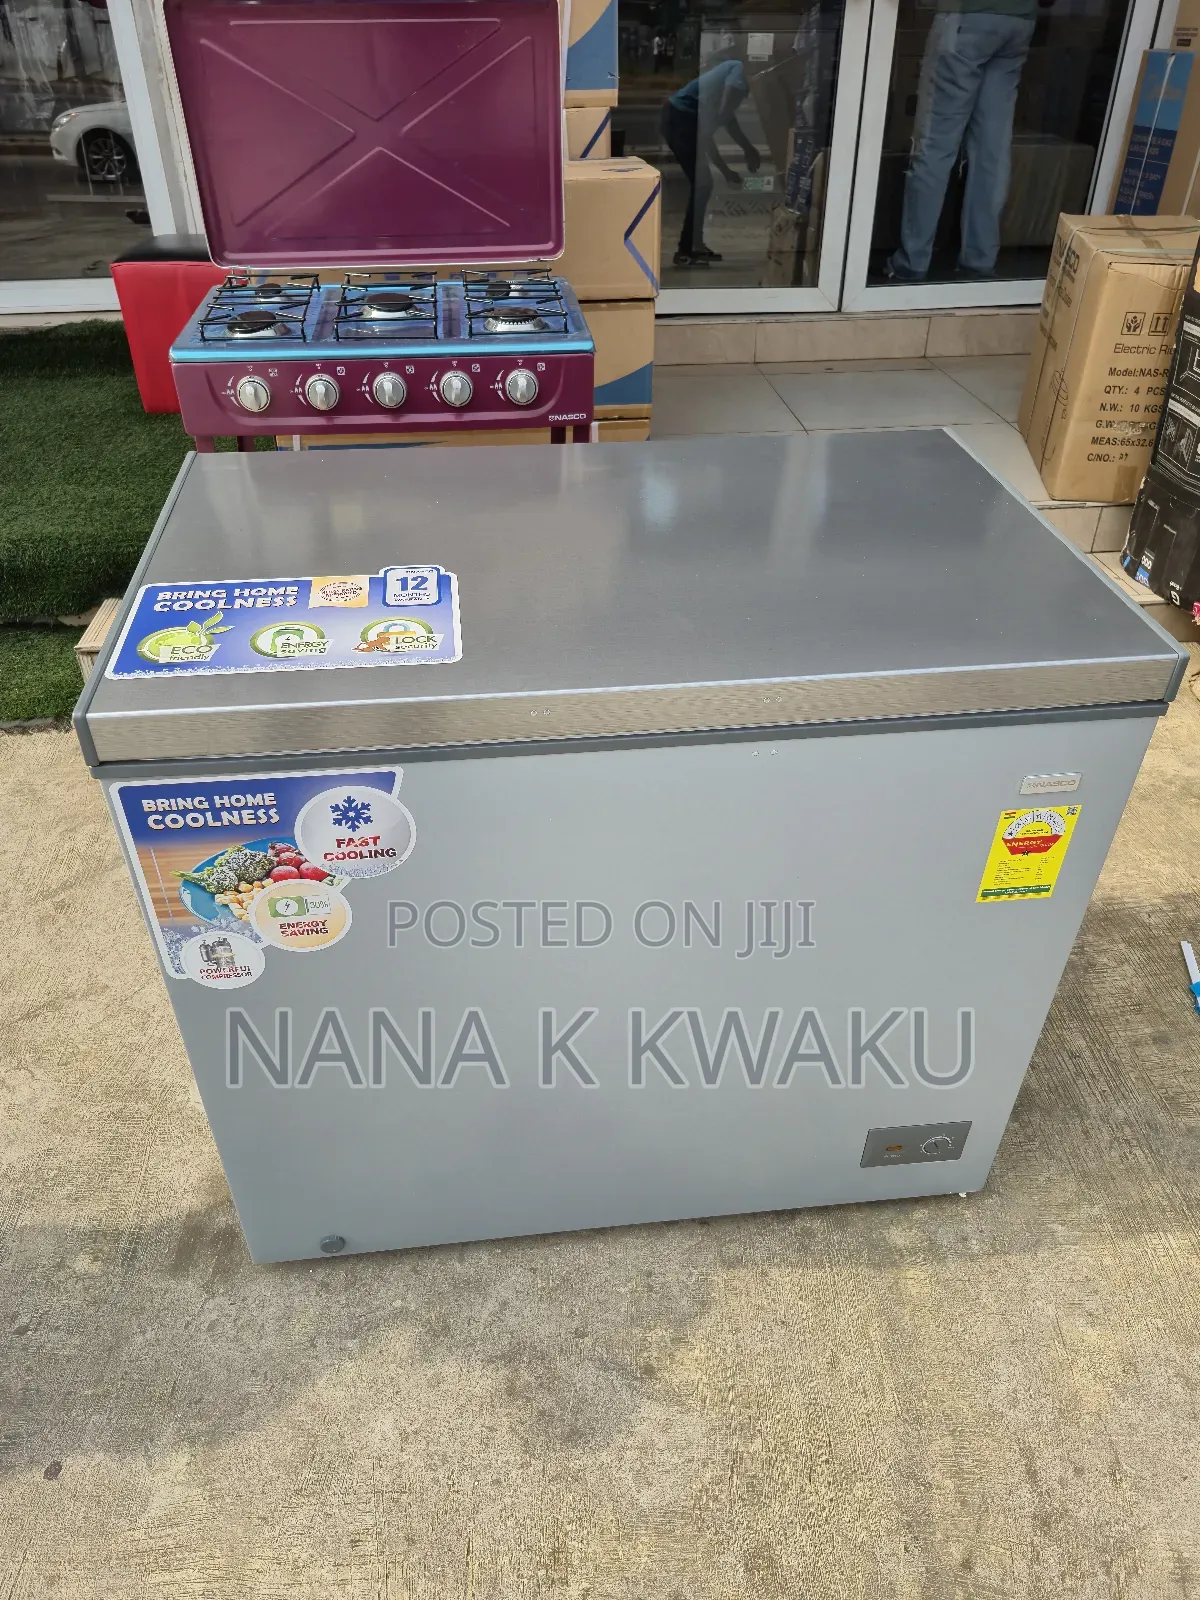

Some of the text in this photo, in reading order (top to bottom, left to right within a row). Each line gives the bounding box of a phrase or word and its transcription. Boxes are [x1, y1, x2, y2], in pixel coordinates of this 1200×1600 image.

[1113, 342, 1157, 355] Electric
[1104, 385, 1166, 396] QTY.: 4 PCS
[1099, 402, 1123, 413] N.W.:
[1129, 403, 1140, 413] 10
[555, 413, 587, 421] NASCO
[1086, 453, 1116, 462] C/NO.:
[395, 575, 429, 591] 12
[156, 586, 300, 601] BRING HOME
[153, 595, 298, 613] COOLNESS
[280, 640, 330, 650] ENERGY
[396, 634, 438, 645] LOCK
[170, 644, 213, 655] ECO
[280, 646, 326, 654] saving
[169, 653, 210, 661] friendly
[141, 792, 277, 812] BRING HOME
[147, 807, 280, 831] COOLNESS
[336, 835, 381, 849] FAST
[323, 847, 397, 862] COOLING
[279, 919, 328, 930] ENERGY
[280, 927, 329, 937] SAVING
[200, 965, 252, 975] POWERFUL
